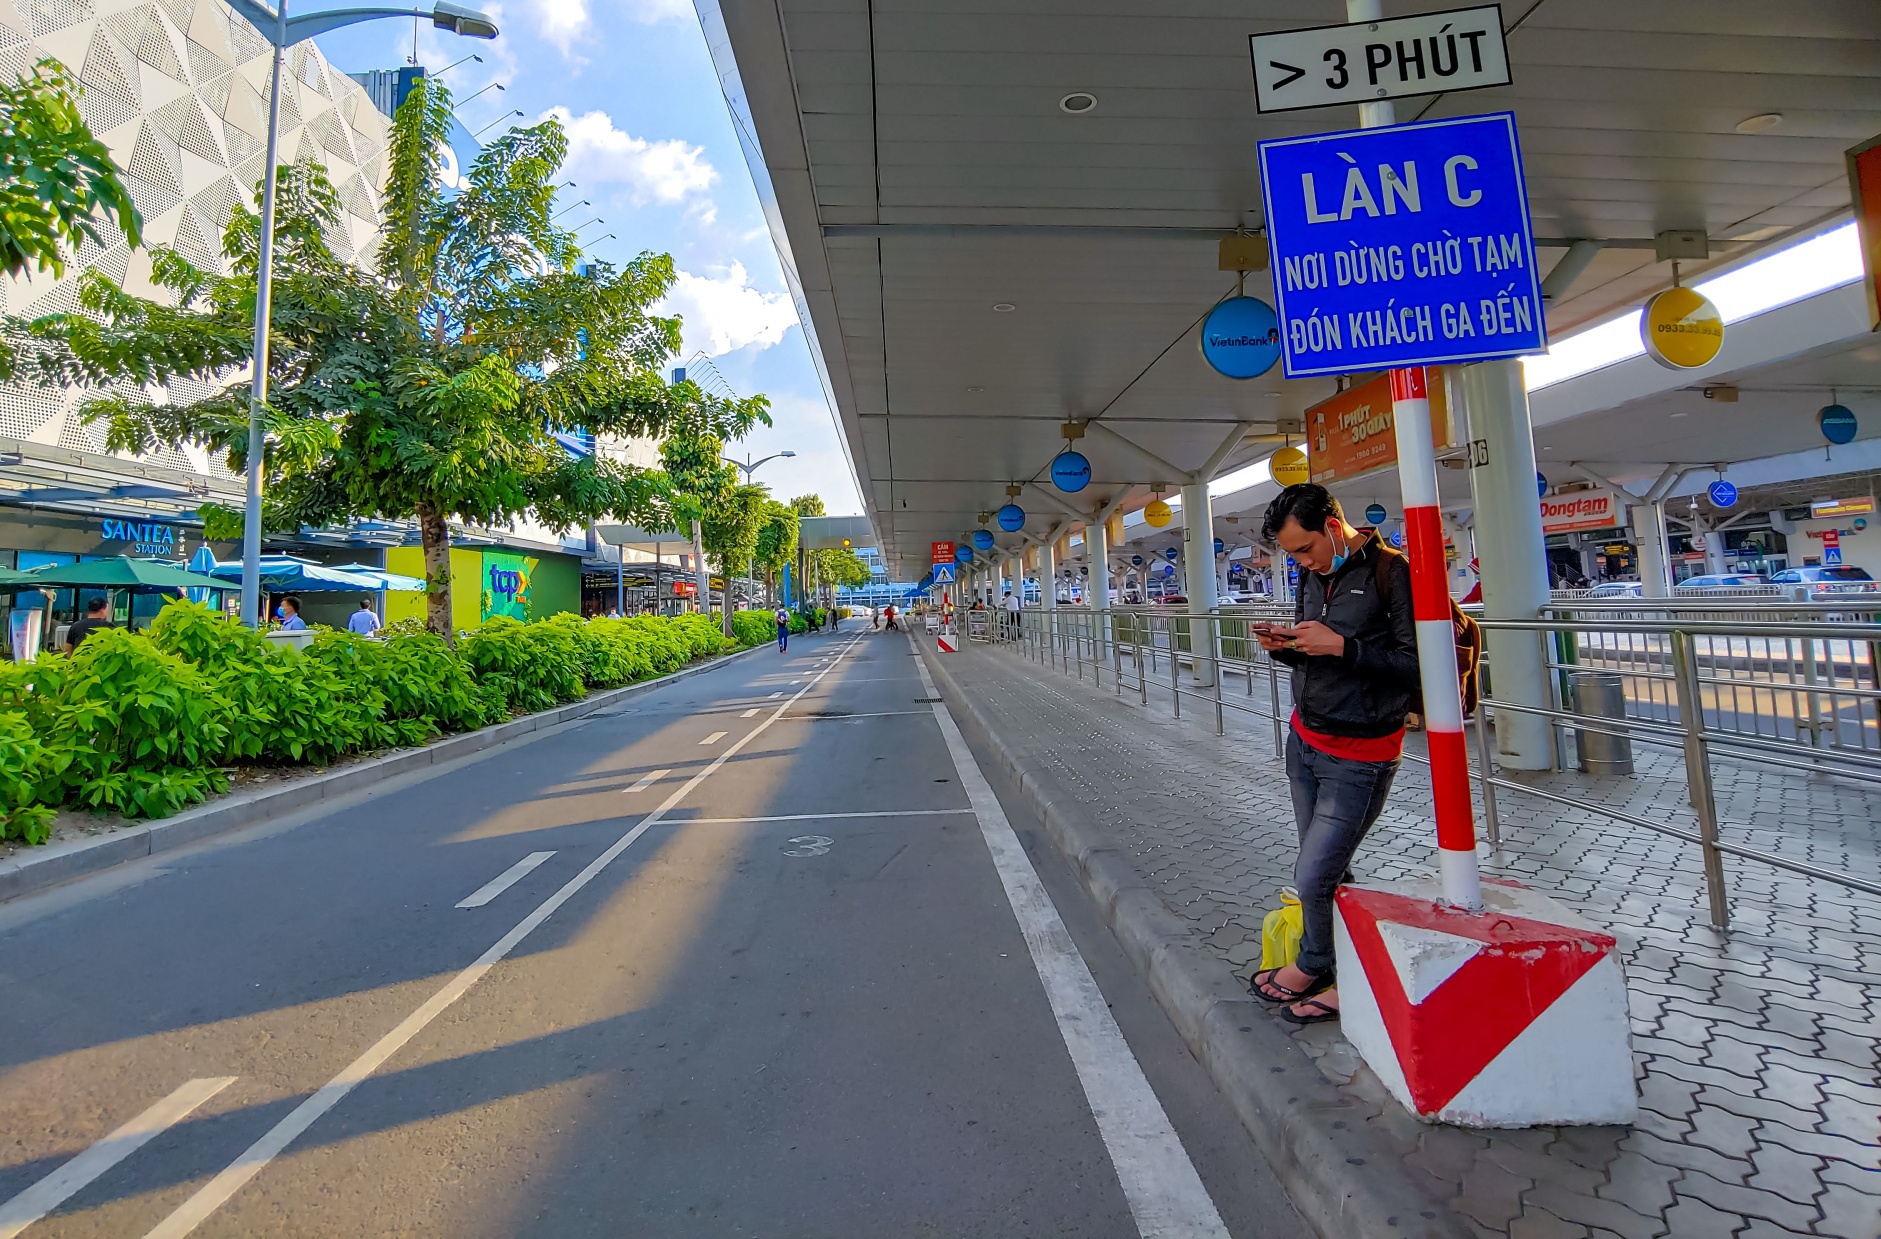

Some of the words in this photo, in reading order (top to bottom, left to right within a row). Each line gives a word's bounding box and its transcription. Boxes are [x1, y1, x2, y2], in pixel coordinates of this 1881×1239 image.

[1322, 48, 1349, 89] 3
[1365, 23, 1487, 86] PHÚT
[1301, 152, 1421, 224] LÀN
[1443, 154, 1483, 208] C
[1284, 251, 1328, 291] NƠI
[1334, 240, 1404, 286] DỪNG
[1411, 229, 1462, 278] CHỜ
[1467, 232, 1523, 277] TẠM
[1290, 307, 1342, 354] ĐÓN
[1348, 298, 1434, 348] KHÁCH
[1440, 301, 1475, 339] GA
[1480, 282, 1532, 336] ĐẾN
[1209, 335, 1269, 347] VietinBank
[1343, 404, 1370, 429] PHÚT
[1351, 423, 1367, 443] 30
[1540, 497, 1608, 518] Dongtam
[101, 518, 174, 545] SANTEA
[134, 543, 173, 555] STATION
